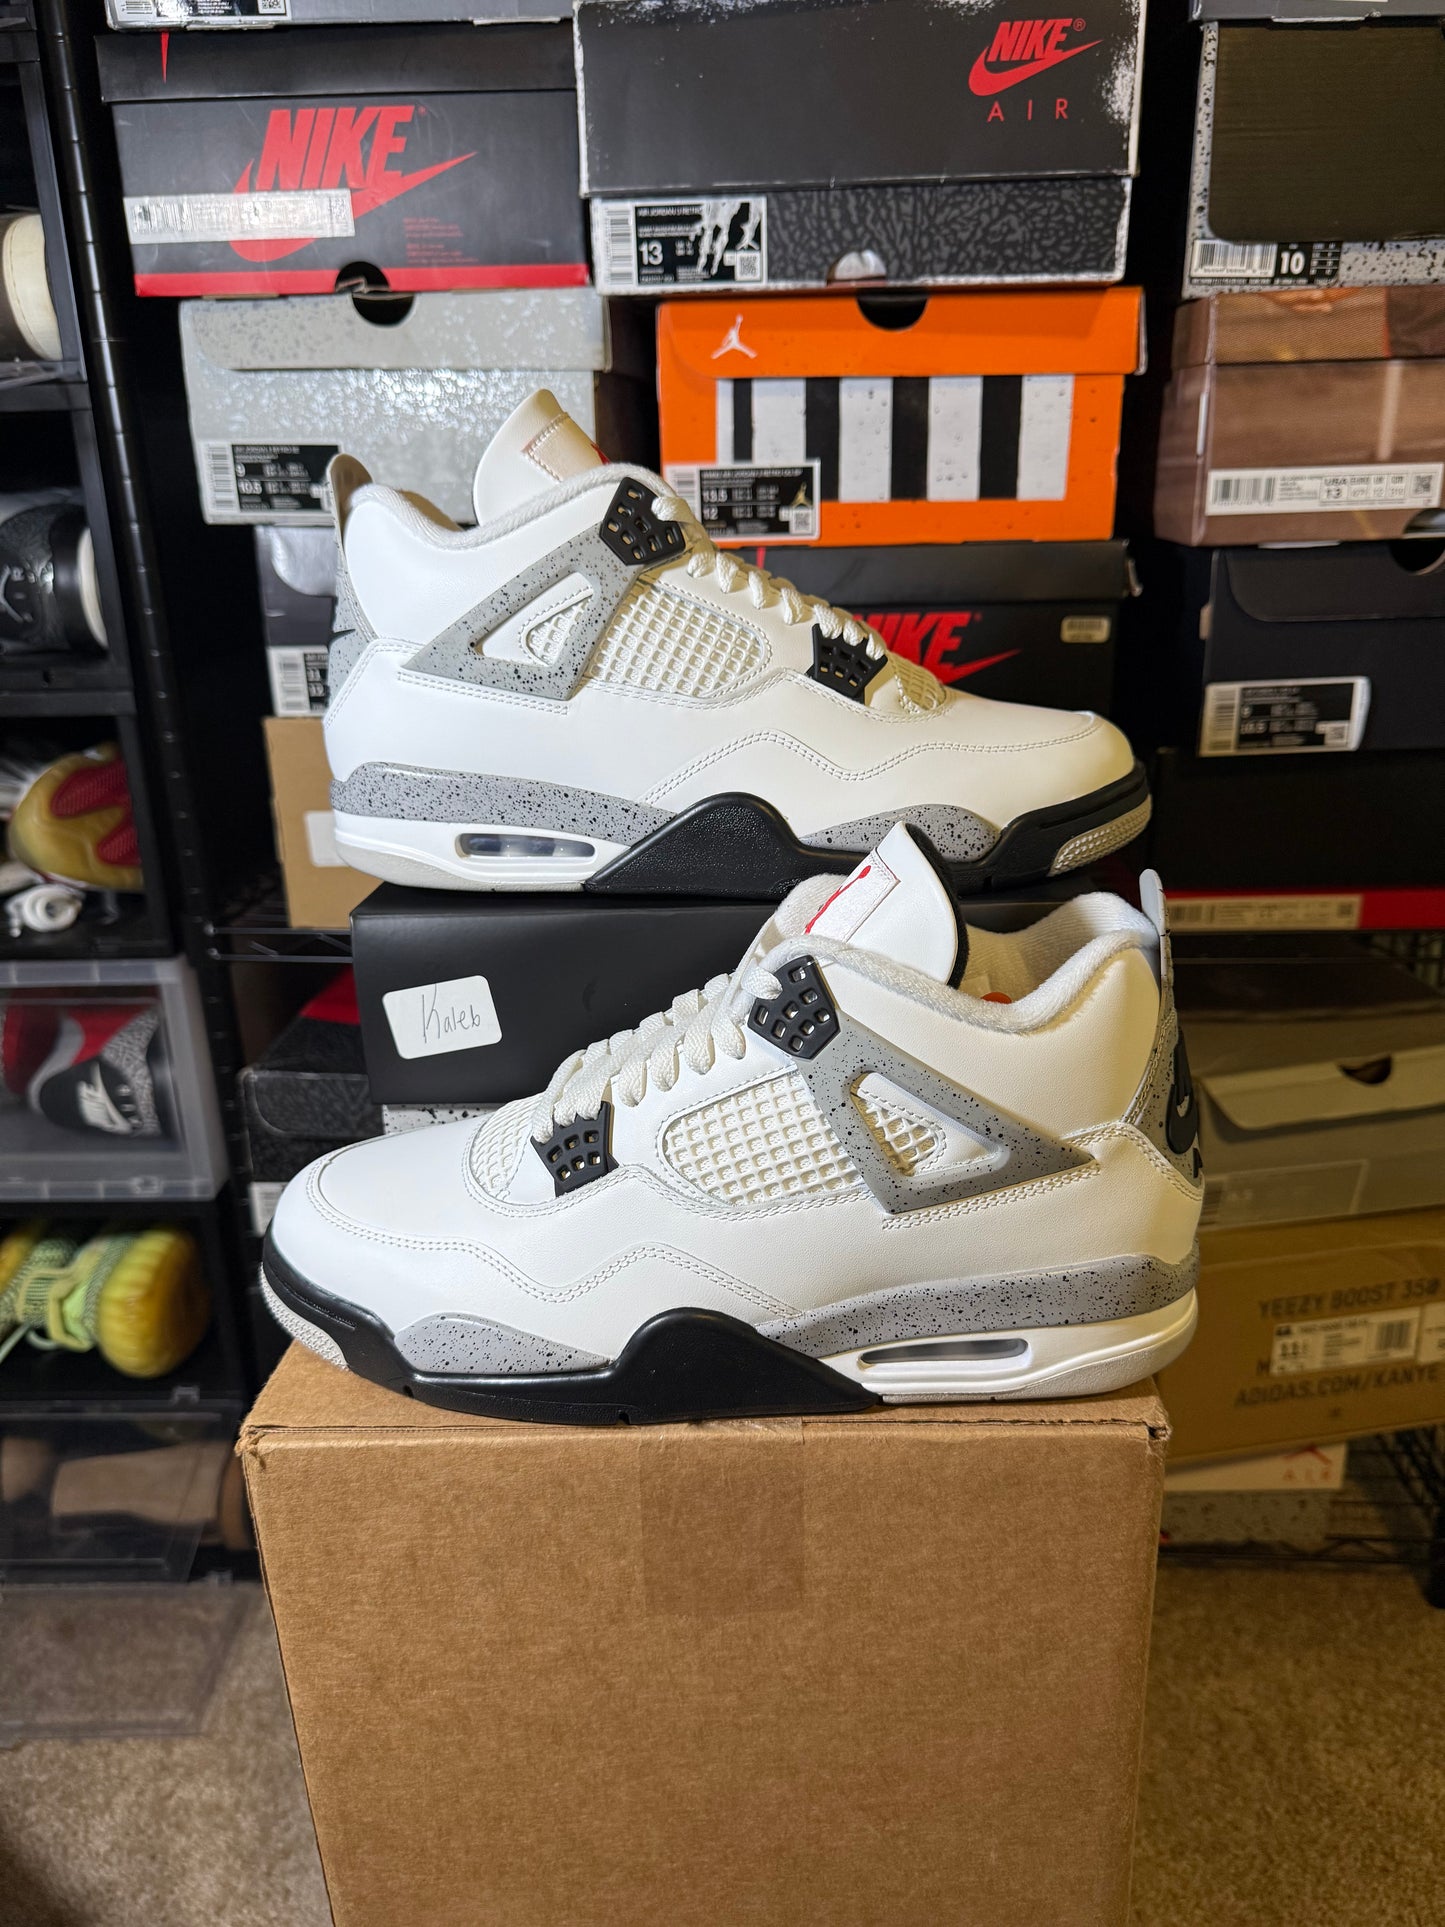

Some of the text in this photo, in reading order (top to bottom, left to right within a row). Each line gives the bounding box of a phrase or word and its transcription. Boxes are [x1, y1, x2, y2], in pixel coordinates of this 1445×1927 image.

[986, 18, 1072, 62] NIKE
[987, 98, 1068, 122] AIR
[256, 105, 415, 190] NIKE
[639, 240, 663, 265] 13
[1281, 251, 1305, 275] 10
[853, 612, 971, 672] IKE
[422, 983, 481, 1043] Kaleb
[1258, 1277, 1441, 1319] YEEZY BOOST 350
[1234, 1363, 1440, 1407] ADIDAS.COM/KANYE
